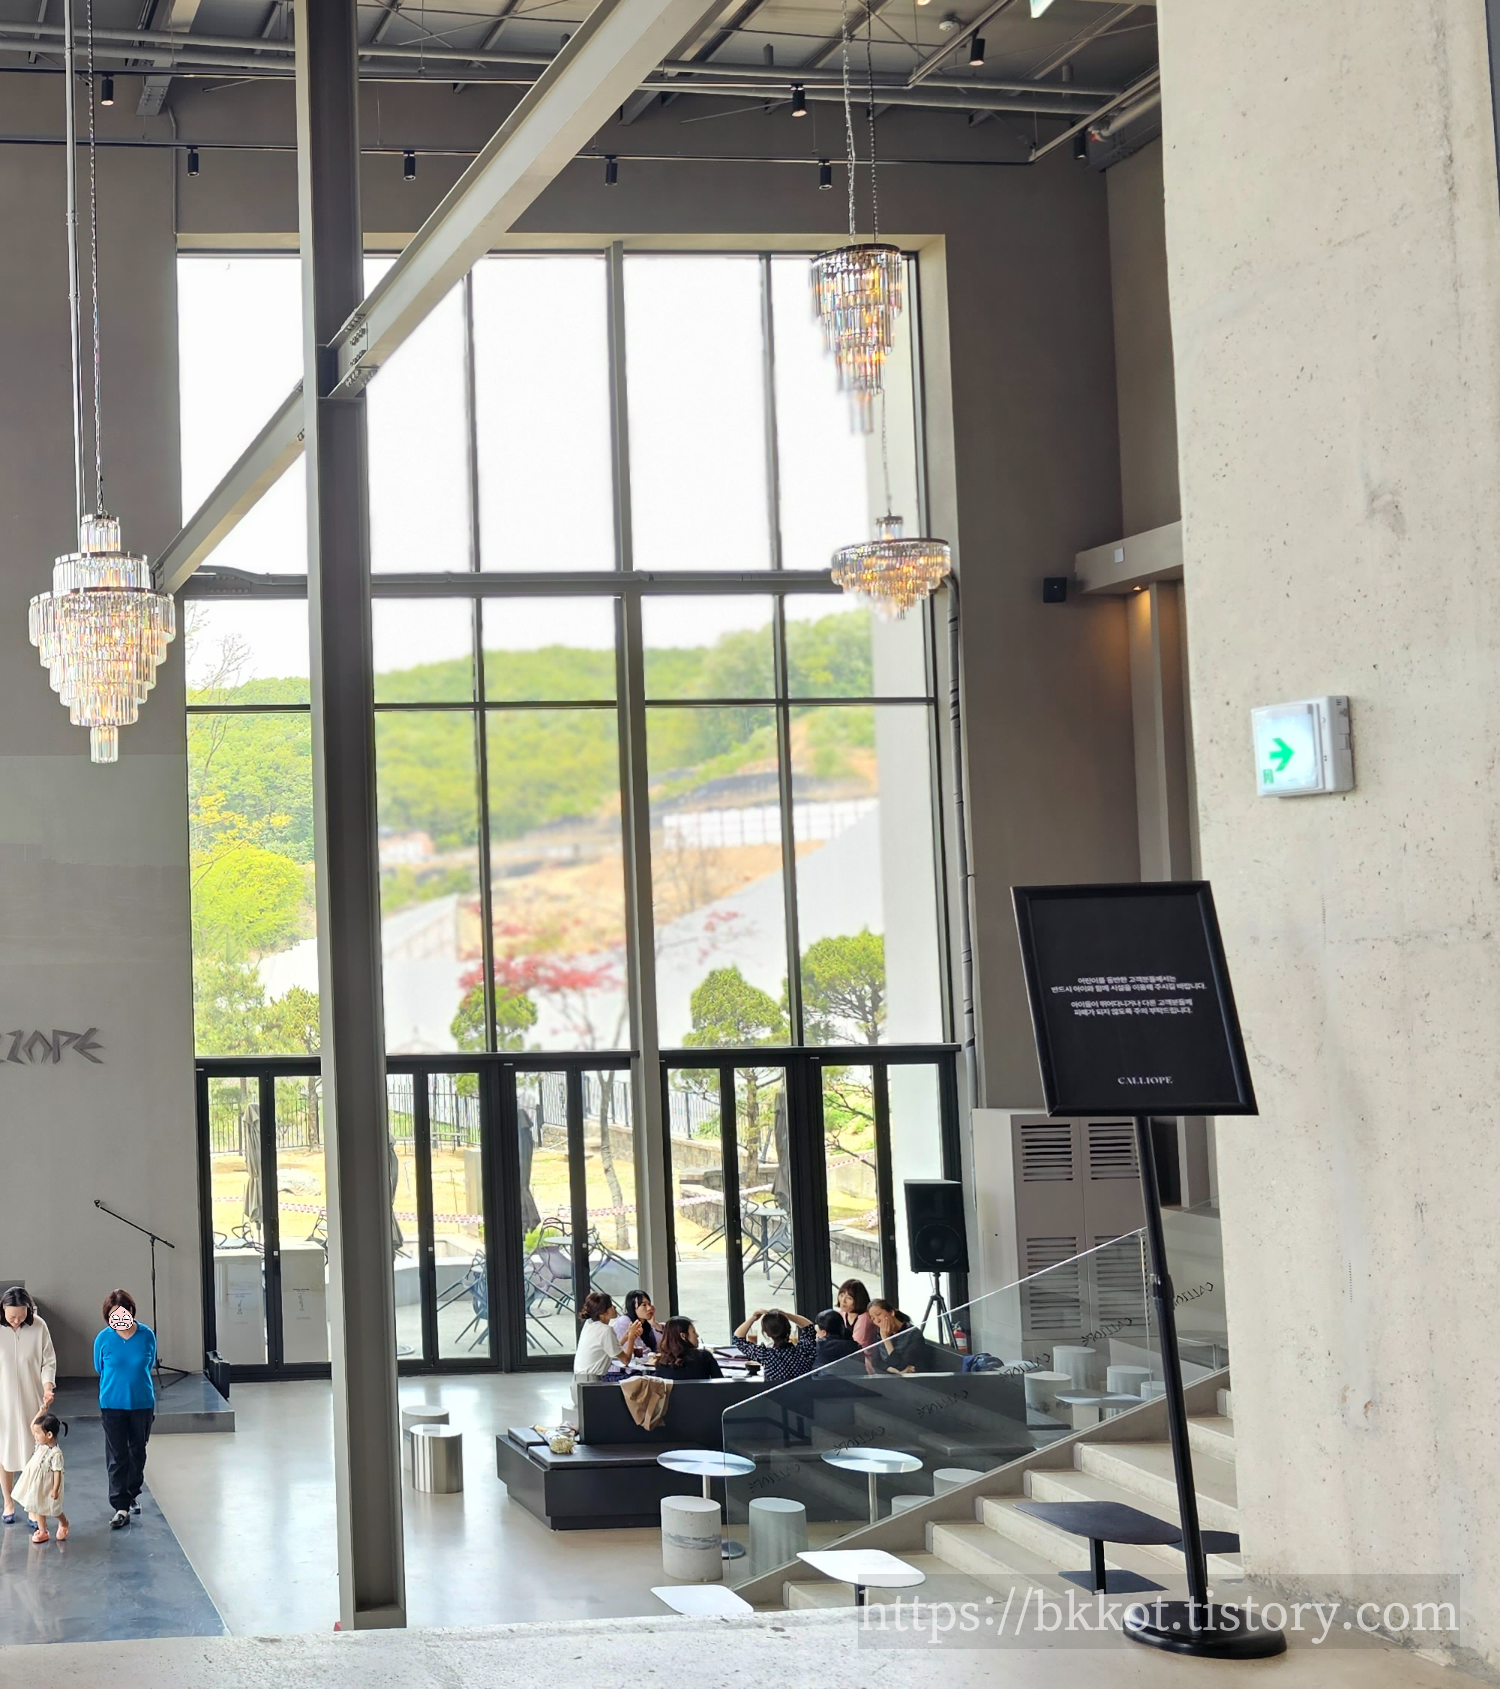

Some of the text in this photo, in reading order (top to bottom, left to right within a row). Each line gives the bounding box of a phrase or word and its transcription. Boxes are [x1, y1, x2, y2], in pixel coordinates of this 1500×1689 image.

[1050, 985, 1073, 993] 반드시
[1073, 984, 1094, 992] 아이와
[1176, 982, 1207, 991] 바랍니다.
[1070, 1000, 1099, 1008] 아이들이
[1099, 999, 1141, 1007] 뛰어다니거나
[1141, 999, 1157, 1007] 다른
[1073, 1008, 1096, 1016] 피해가
[1095, 1008, 1111, 1016] 되지
[1111, 1007, 1133, 1015] 않도록
[1148, 1006, 1193, 1015] 부탁드립니다.
[1117, 1076, 1173, 1085] CALLIOPE
